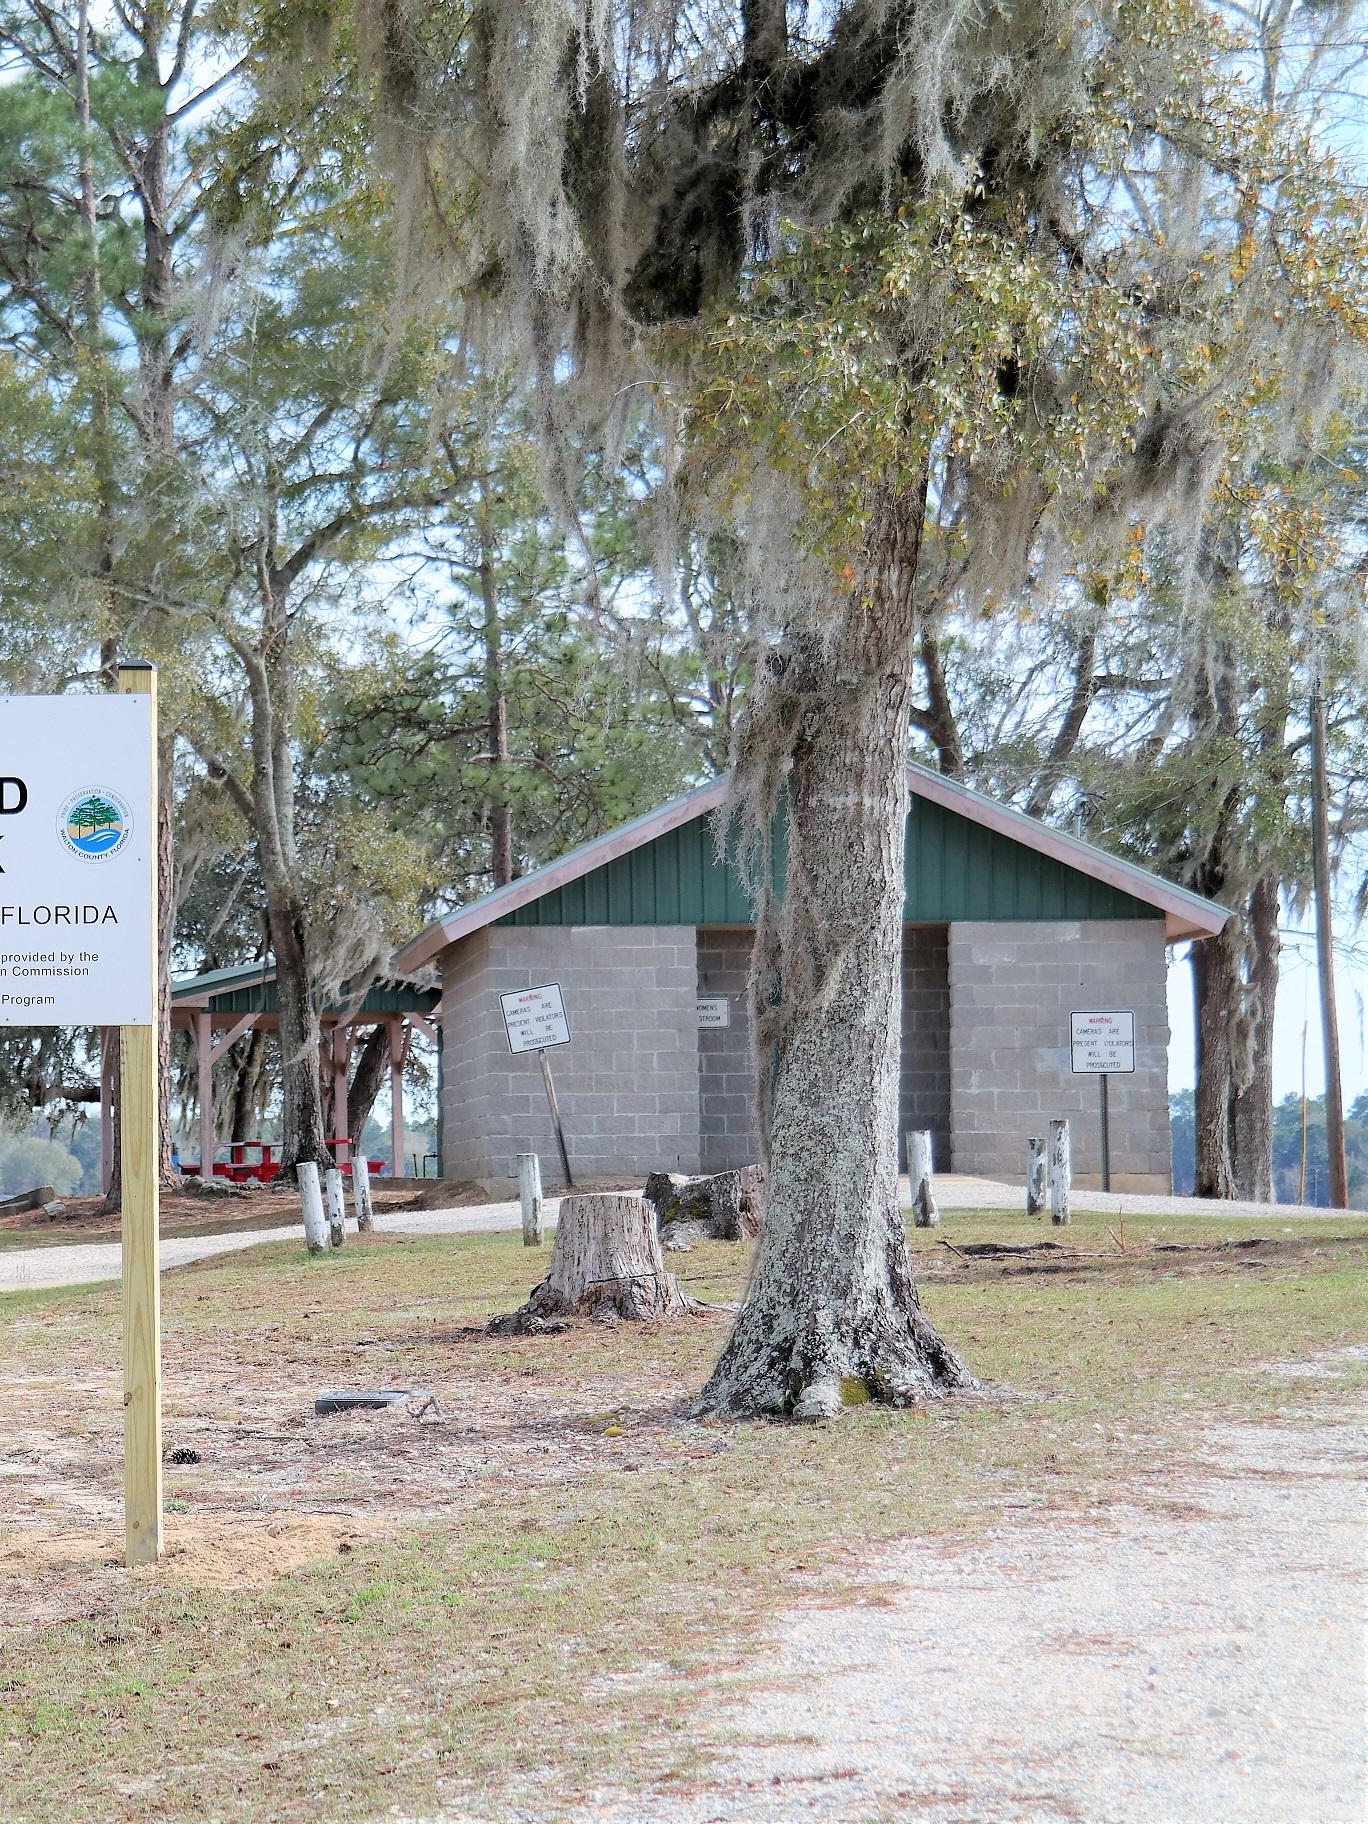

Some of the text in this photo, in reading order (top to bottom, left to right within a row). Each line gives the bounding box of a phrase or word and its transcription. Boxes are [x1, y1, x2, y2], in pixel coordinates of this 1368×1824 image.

[61, 829, 77, 854] WALTON
[111, 829, 129, 854] FLORIDA
[1, 905, 119, 925] FLORIDA
[1, 952, 55, 965] provided
[60, 952, 75, 965] by
[79, 952, 99, 962] the
[12, 966, 89, 977] Commission
[2, 995, 55, 1008] Program
[506, 1007, 531, 1016] CAMERAS
[508, 1012, 563, 1028] PRESENT VIOLATORS
